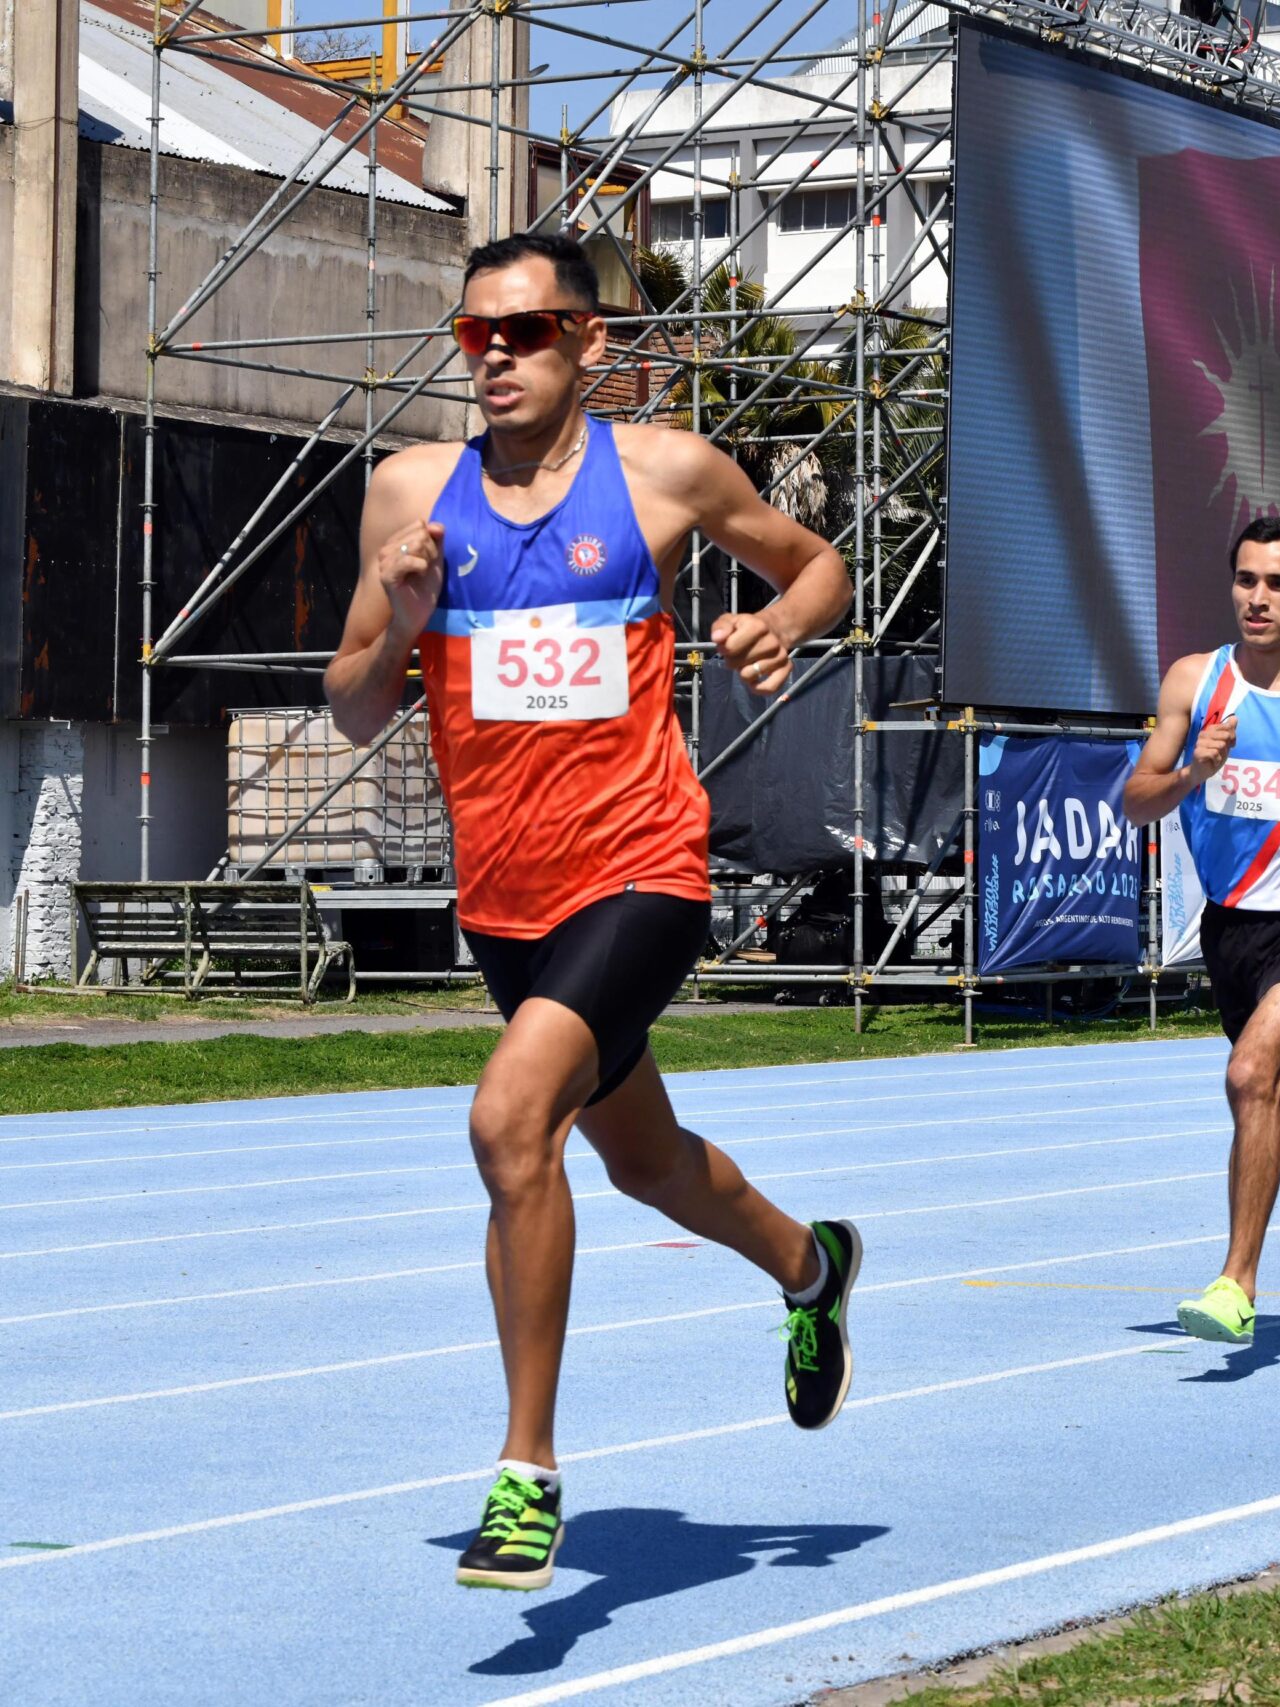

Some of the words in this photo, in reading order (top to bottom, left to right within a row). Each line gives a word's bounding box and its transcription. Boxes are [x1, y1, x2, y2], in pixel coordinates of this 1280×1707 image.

[497, 637, 601, 688] 532
[526, 695, 568, 709] 2025
[1236, 800, 1262, 812] 2025
